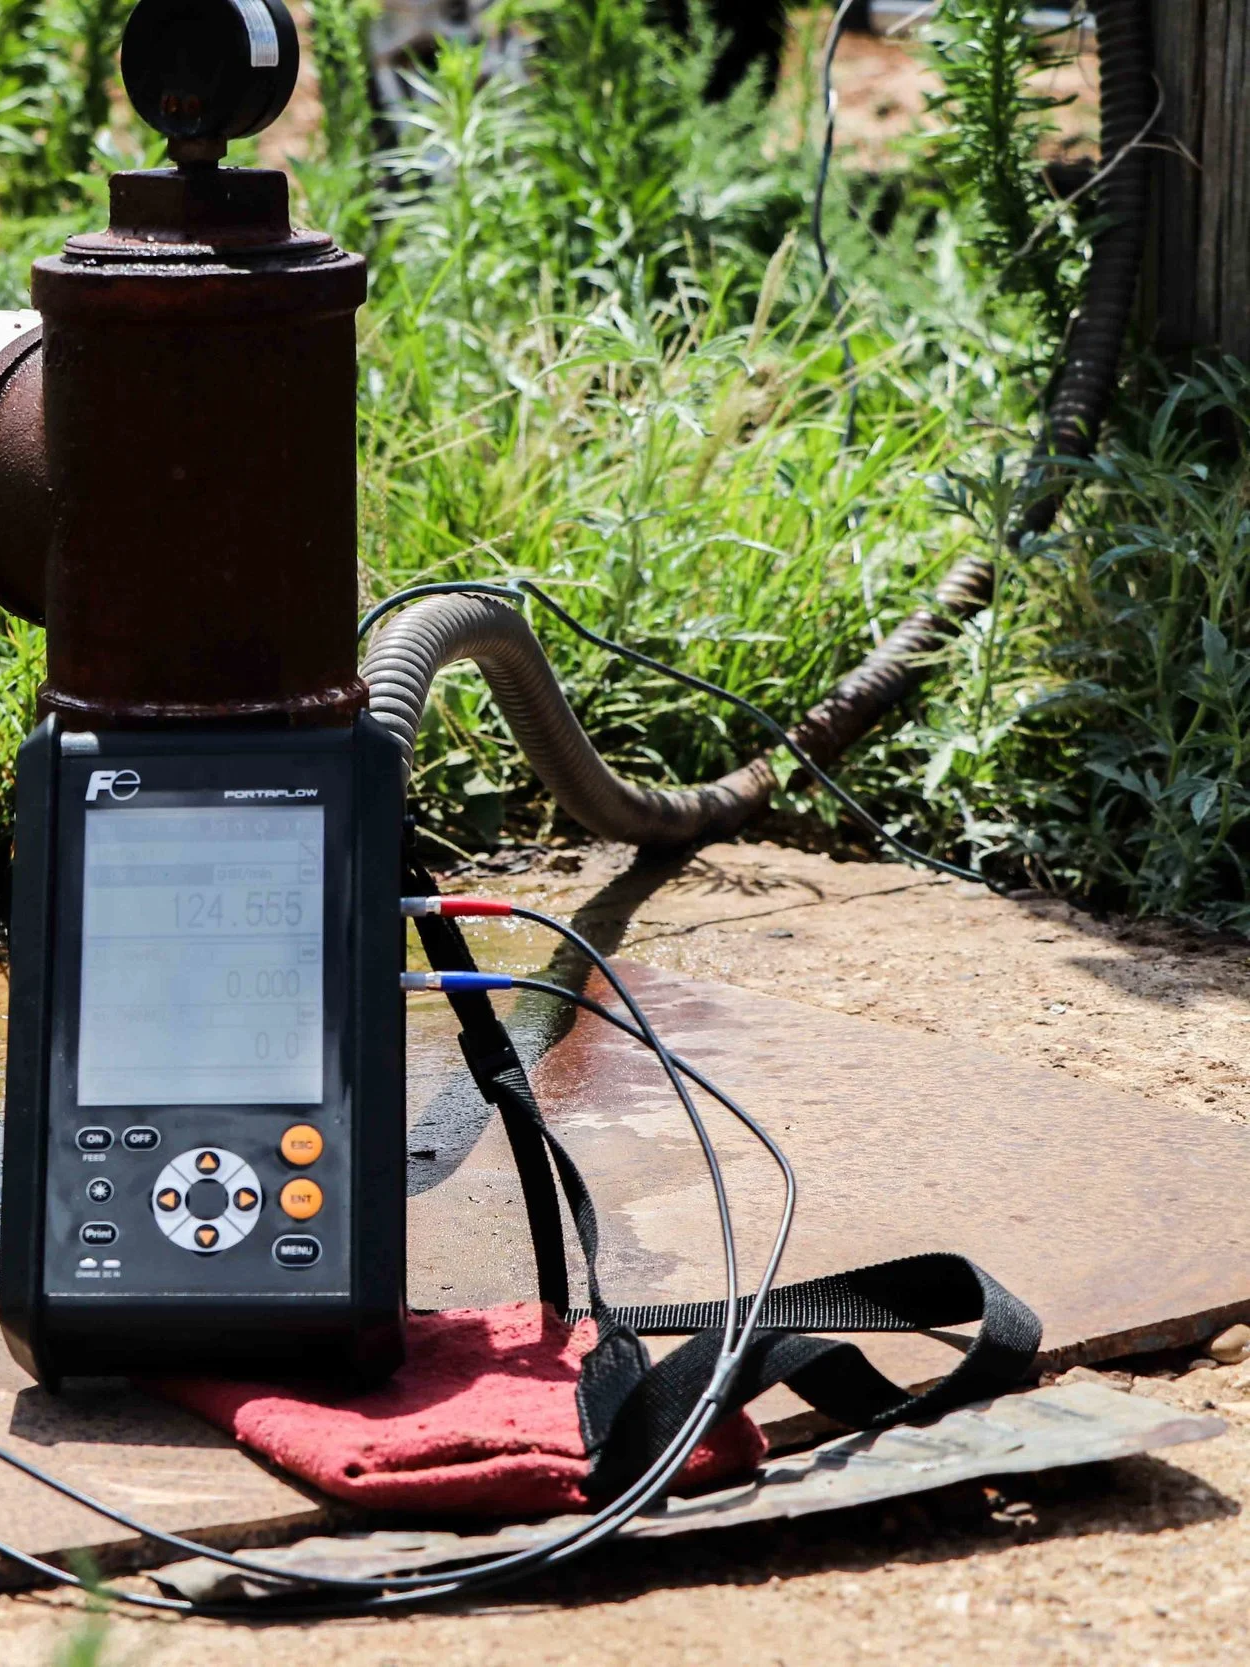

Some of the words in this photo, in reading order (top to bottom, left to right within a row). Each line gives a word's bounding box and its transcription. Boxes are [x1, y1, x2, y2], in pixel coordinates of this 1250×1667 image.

[224, 788, 318, 799] PORTAFLOW
[173, 891, 303, 929] 124.555
[226, 969, 300, 999] 0.000
[255, 1031, 300, 1060] 0.0
[86, 1133, 104, 1144] ON
[129, 1133, 152, 1144] OFF
[290, 1140, 313, 1150] ESC
[82, 1153, 107, 1162] FEED
[291, 1194, 312, 1204] ENT
[84, 1228, 112, 1239] Print
[281, 1245, 313, 1256] MENU
